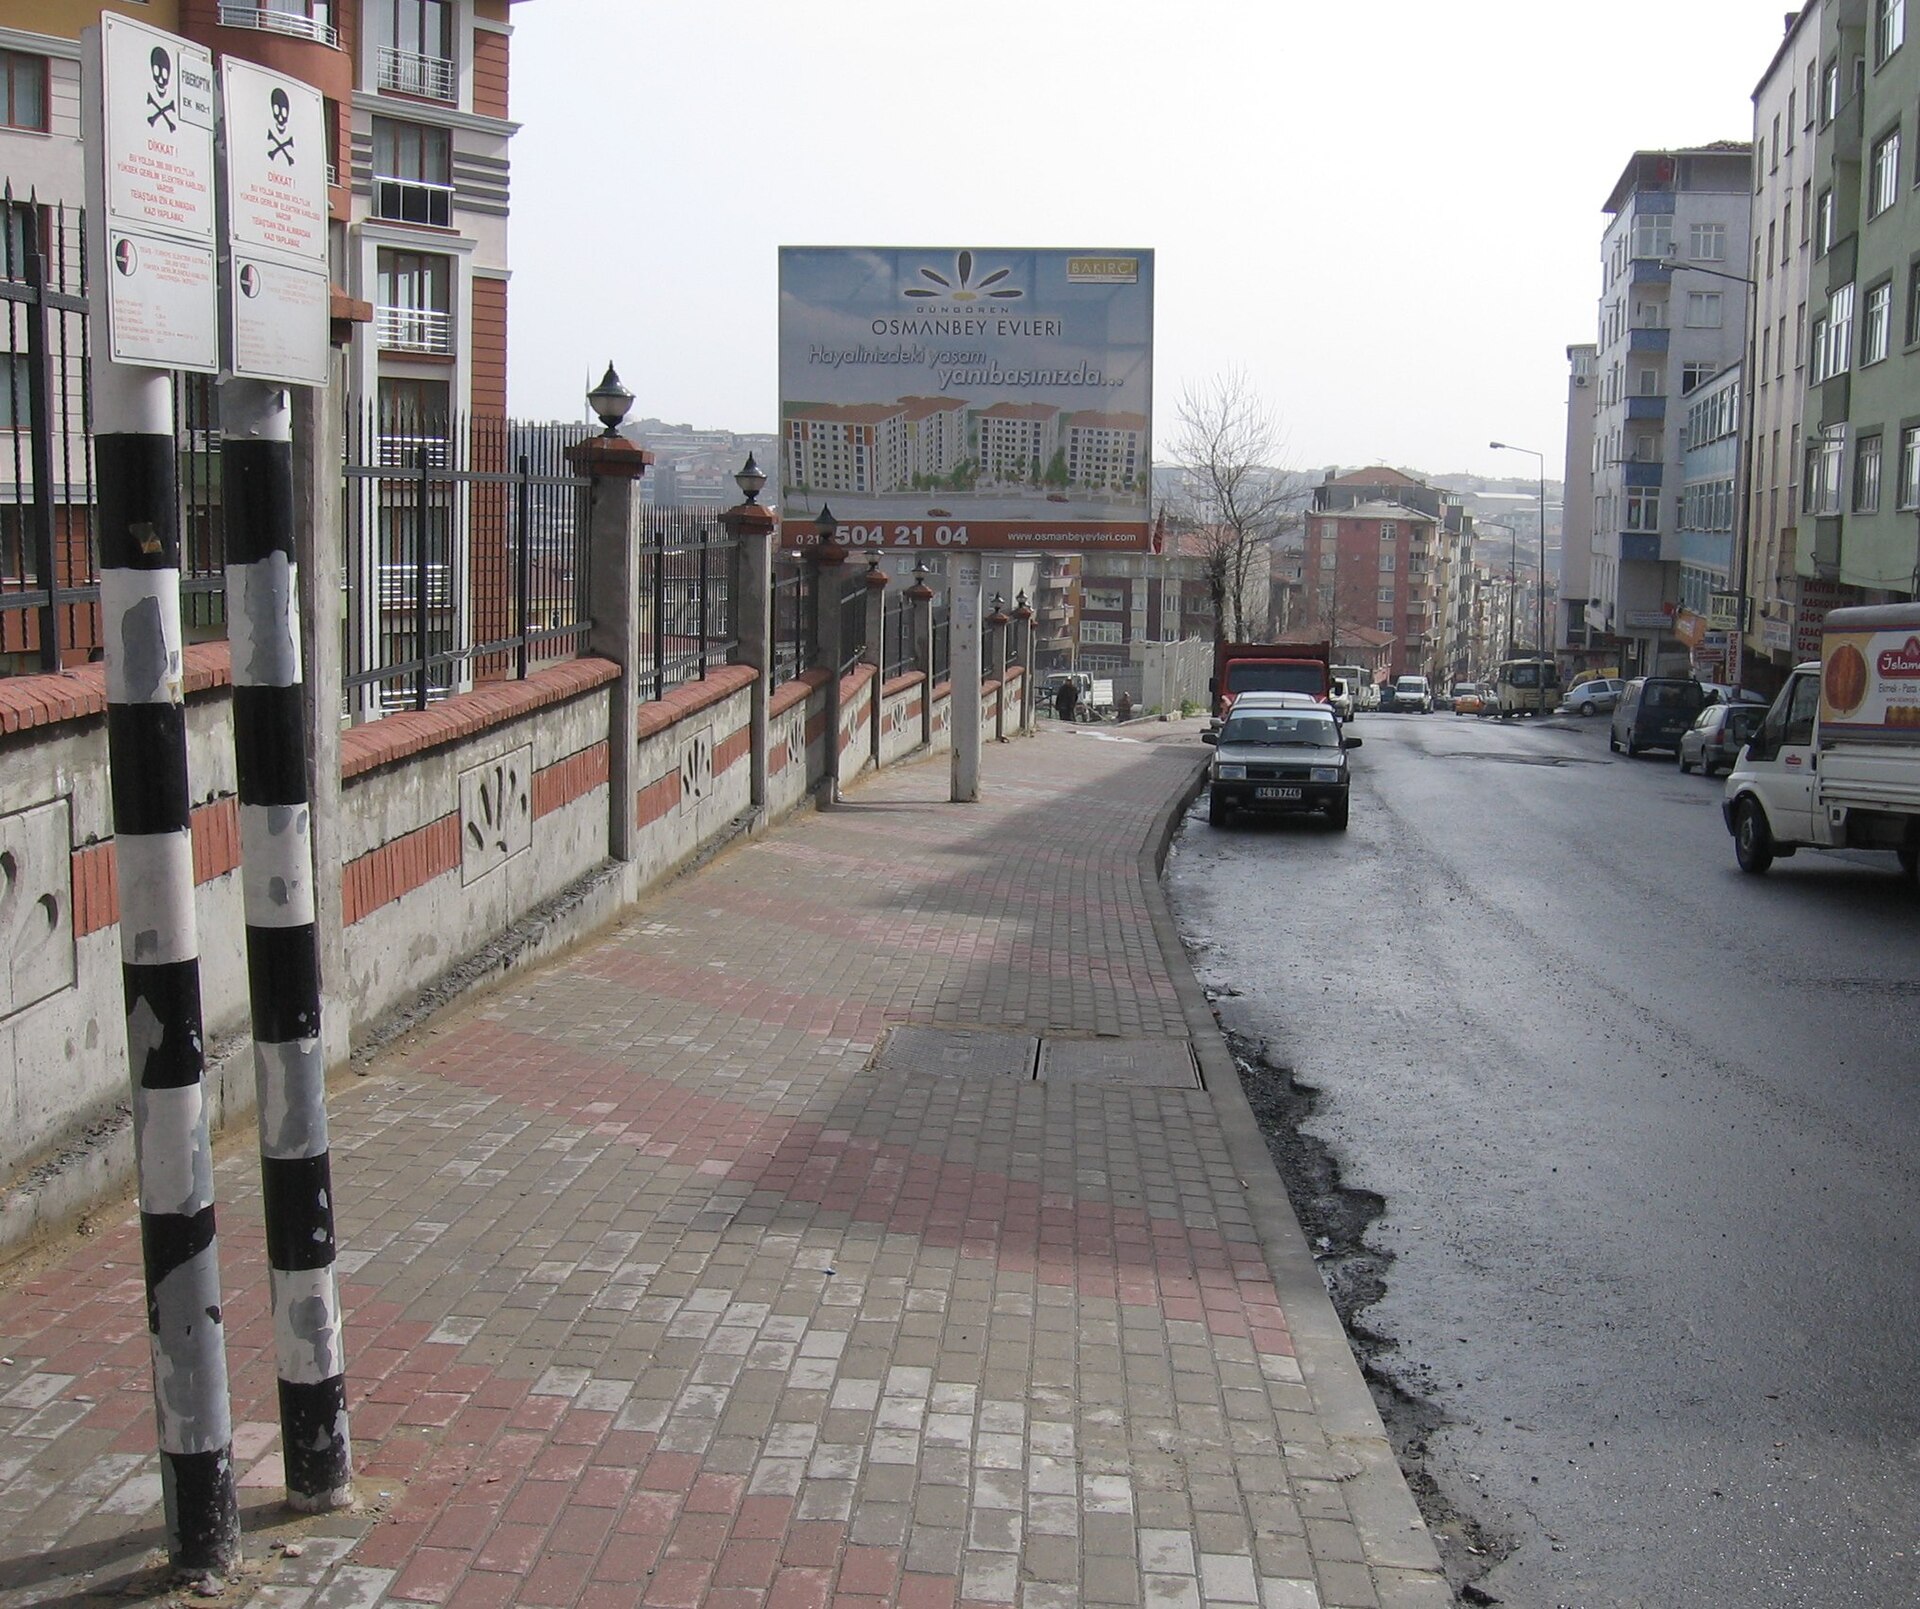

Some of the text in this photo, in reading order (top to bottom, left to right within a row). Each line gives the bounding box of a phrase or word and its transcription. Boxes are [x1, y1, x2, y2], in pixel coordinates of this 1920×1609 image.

[147, 137, 174, 156] DİKKAT
[118, 162, 138, 174] YÜKSEK
[268, 171, 292, 188] DİKKAT
[916, 306, 1010, 314] GÜNGÖREN
[872, 320, 1062, 336] OSMANBEY EVLERİ
[808, 344, 986, 368] Hayalinizdeki yaşam
[834, 525, 884, 545] 504
[894, 525, 923, 545] 21
[935, 525, 969, 545] 04
[1008, 532, 1136, 542] www.osmanbeyevleri.com
